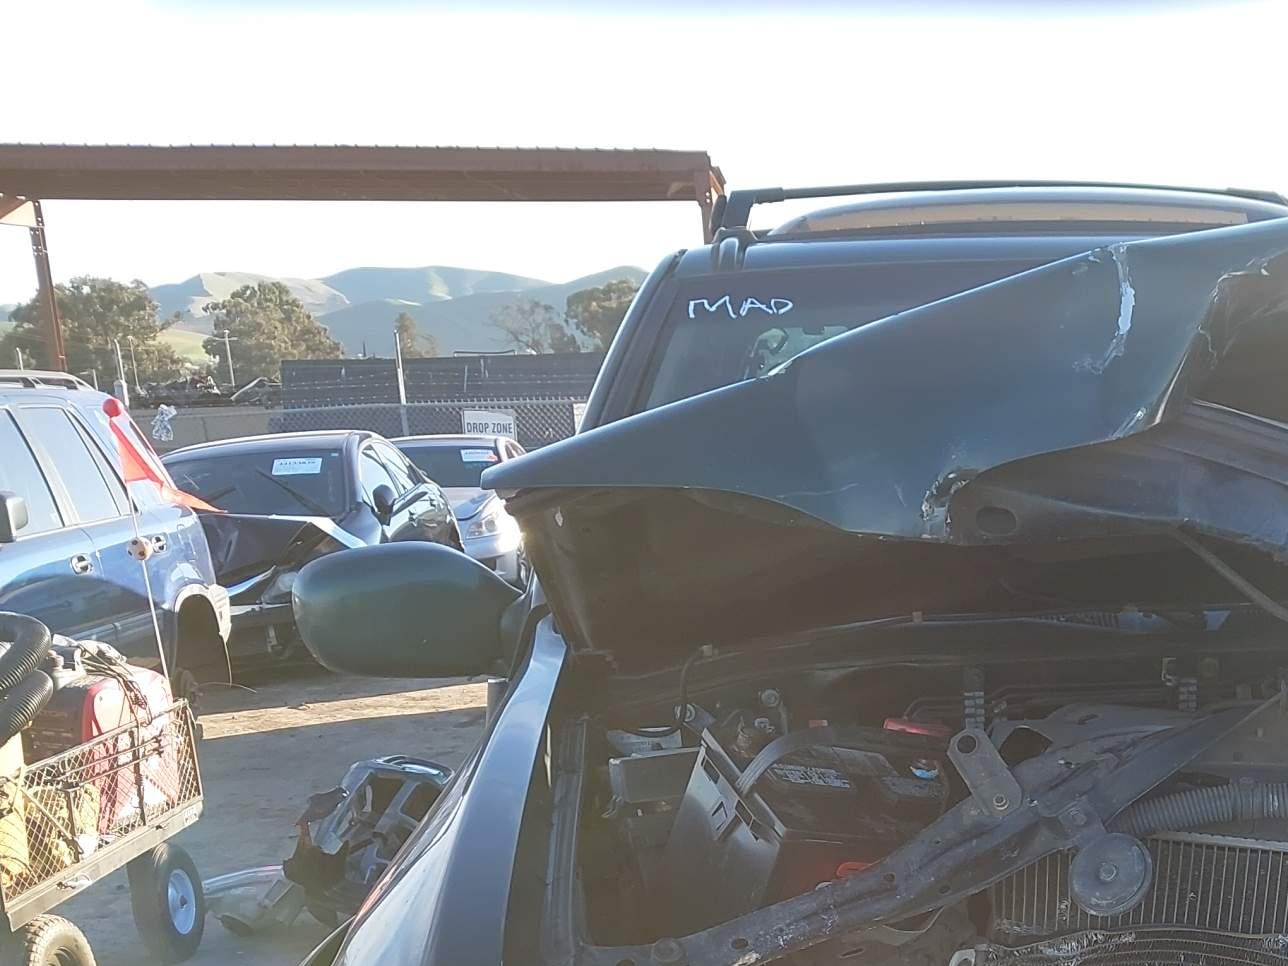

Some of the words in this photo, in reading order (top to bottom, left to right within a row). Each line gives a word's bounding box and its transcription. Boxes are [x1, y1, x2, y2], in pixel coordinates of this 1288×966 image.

[688, 295, 794, 319] MAD
[466, 422, 489, 433] DROP
[492, 422, 513, 434] ZONE
